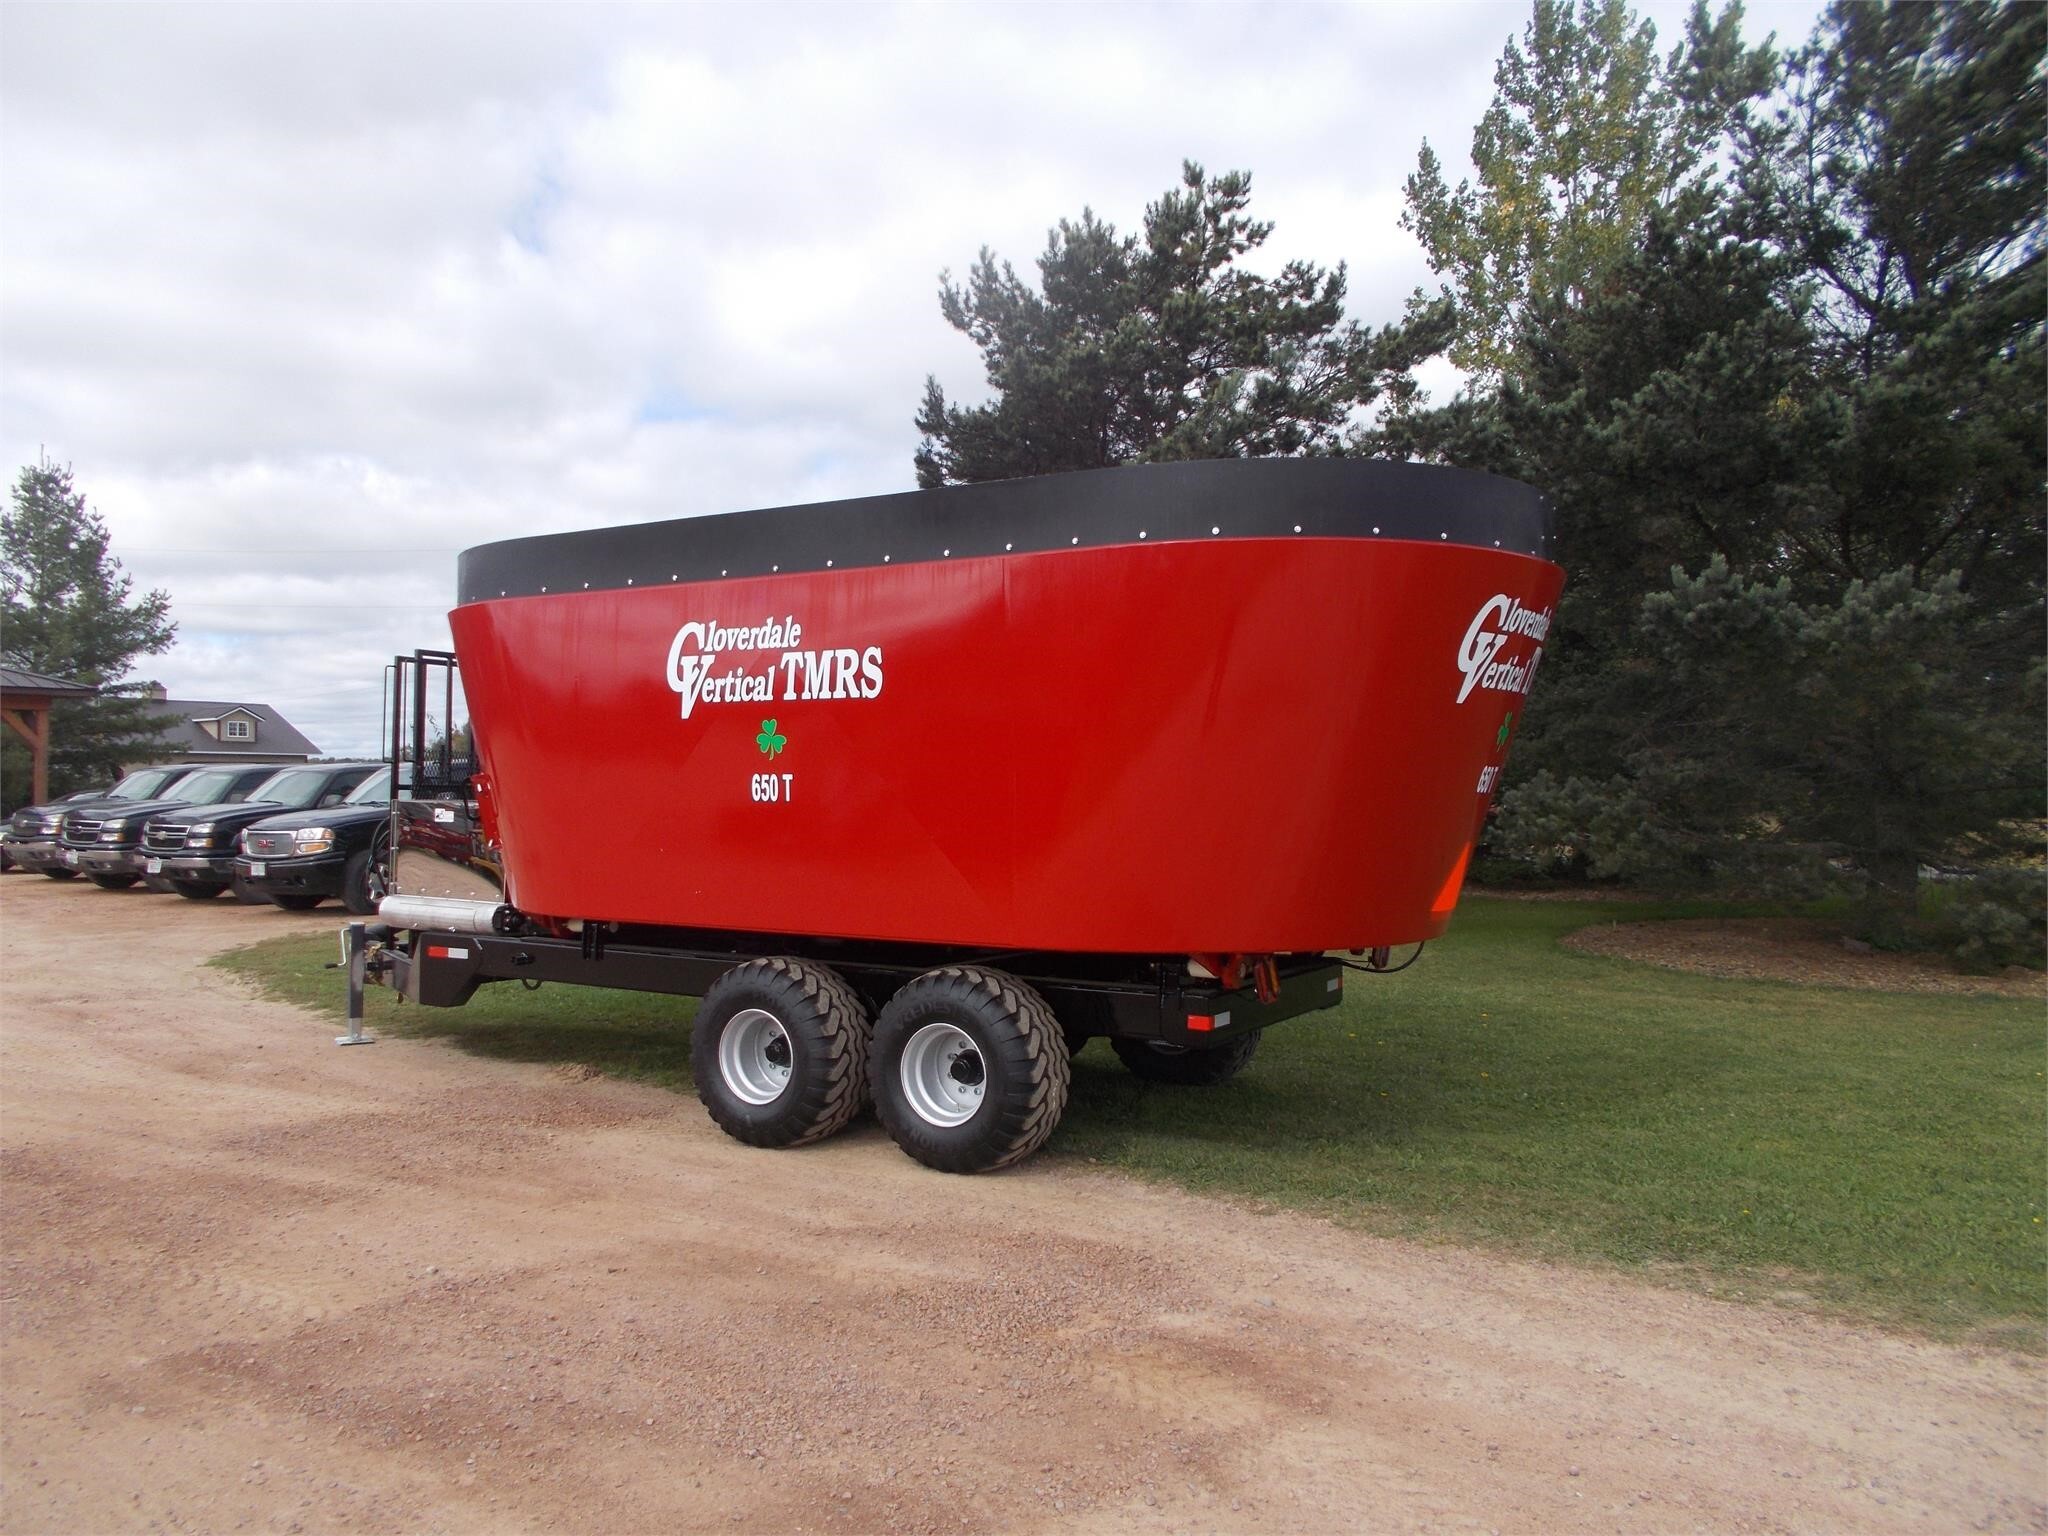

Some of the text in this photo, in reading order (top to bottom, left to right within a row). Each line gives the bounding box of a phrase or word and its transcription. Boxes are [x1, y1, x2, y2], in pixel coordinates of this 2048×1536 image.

[666, 615, 802, 693] Cloverdale
[680, 646, 884, 720] Vertical TMRS
[751, 773, 794, 802] 650 T
